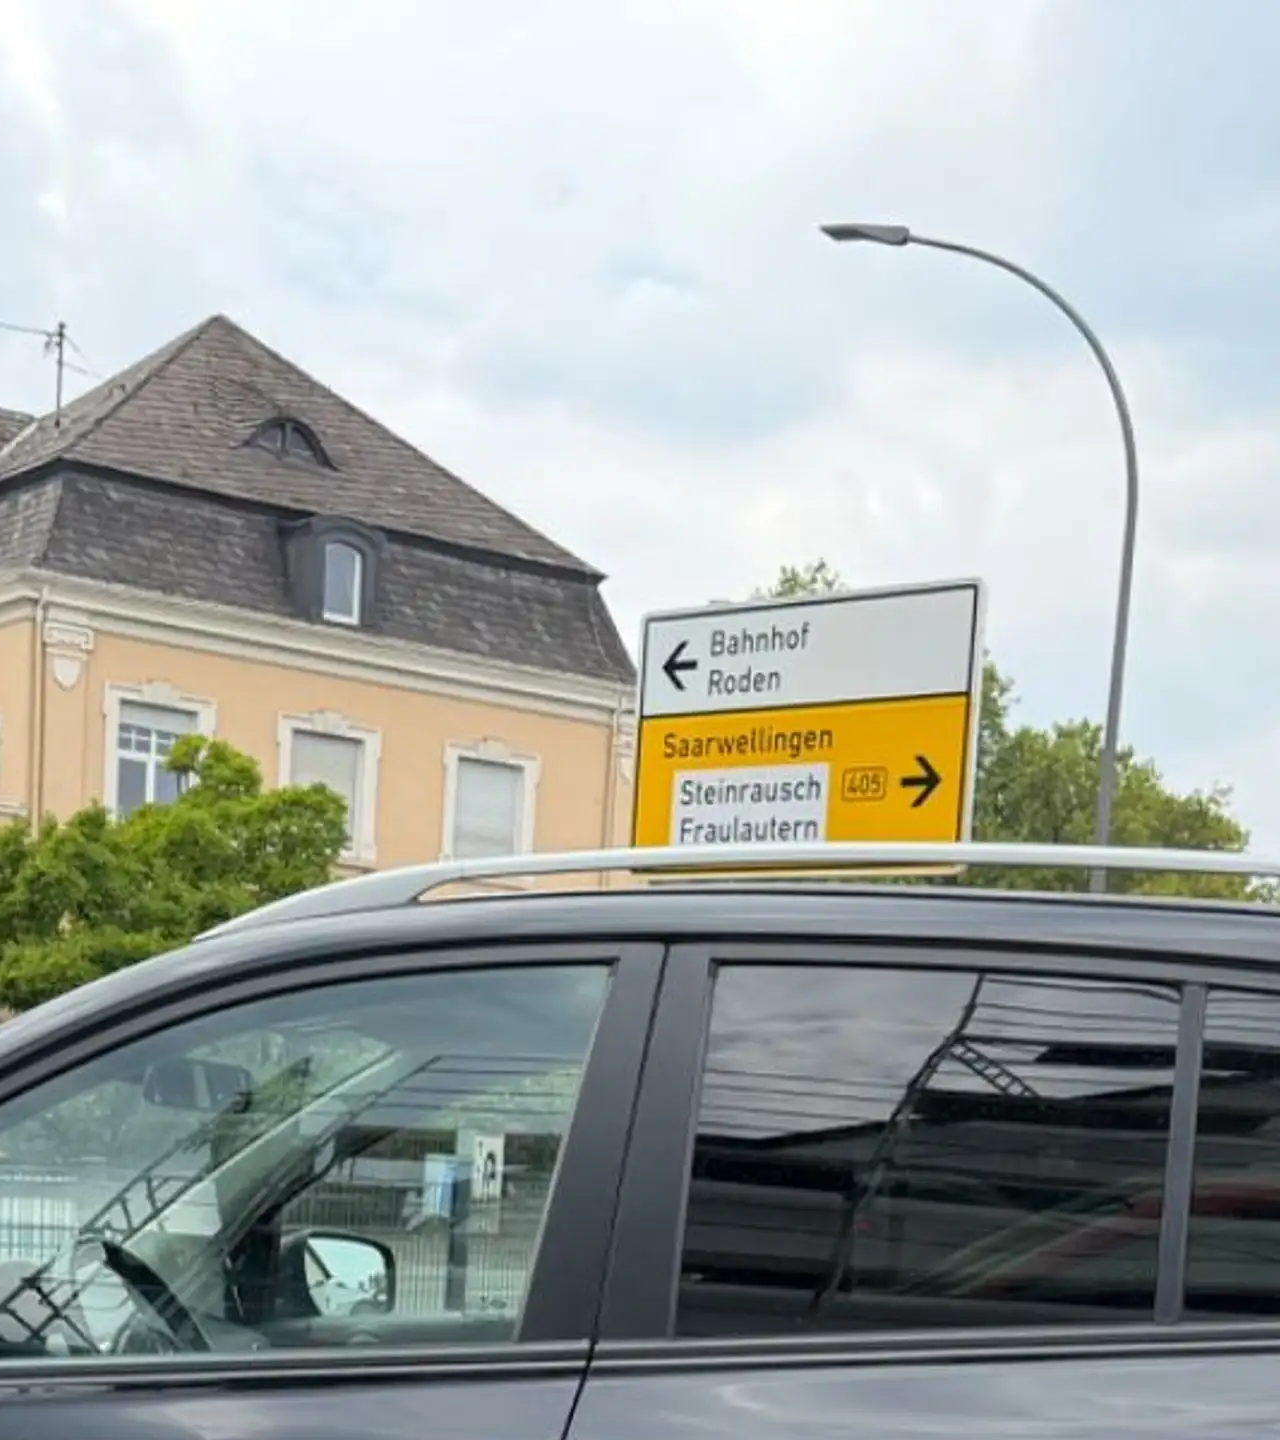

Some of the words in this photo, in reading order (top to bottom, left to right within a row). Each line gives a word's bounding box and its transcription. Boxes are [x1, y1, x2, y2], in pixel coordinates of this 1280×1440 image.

[709, 622, 810, 657] Bahnhof
[707, 668, 781, 696] Roden
[663, 727, 834, 760] Saarwellingen
[680, 774, 821, 806] Steinrausch
[847, 773, 881, 795] 405
[679, 814, 819, 845] Fraulautern
